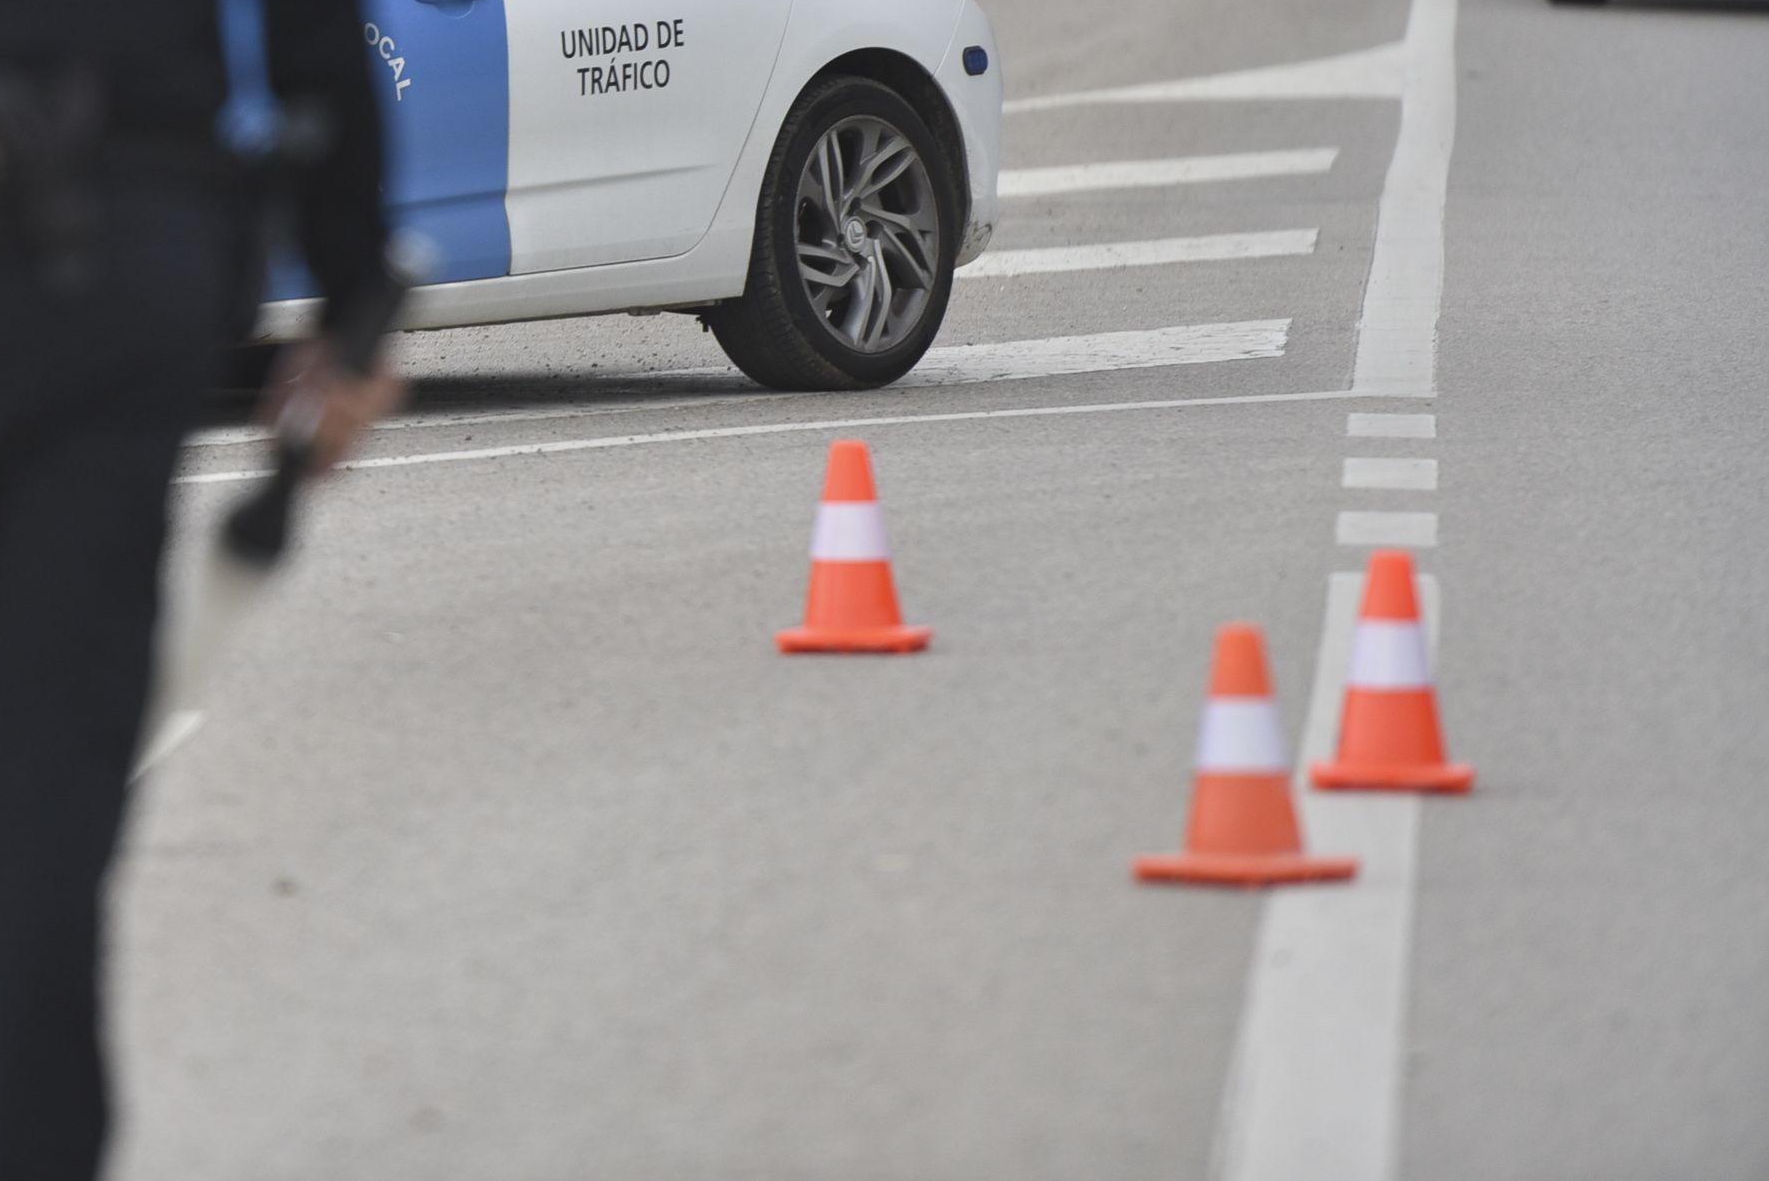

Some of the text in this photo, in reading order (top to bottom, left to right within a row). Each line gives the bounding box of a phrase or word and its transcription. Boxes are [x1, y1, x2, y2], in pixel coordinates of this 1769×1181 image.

[561, 19, 685, 59] UNIDAD DE
[364, 22, 411, 101] OCAL
[577, 57, 671, 97] TRÁFICO
